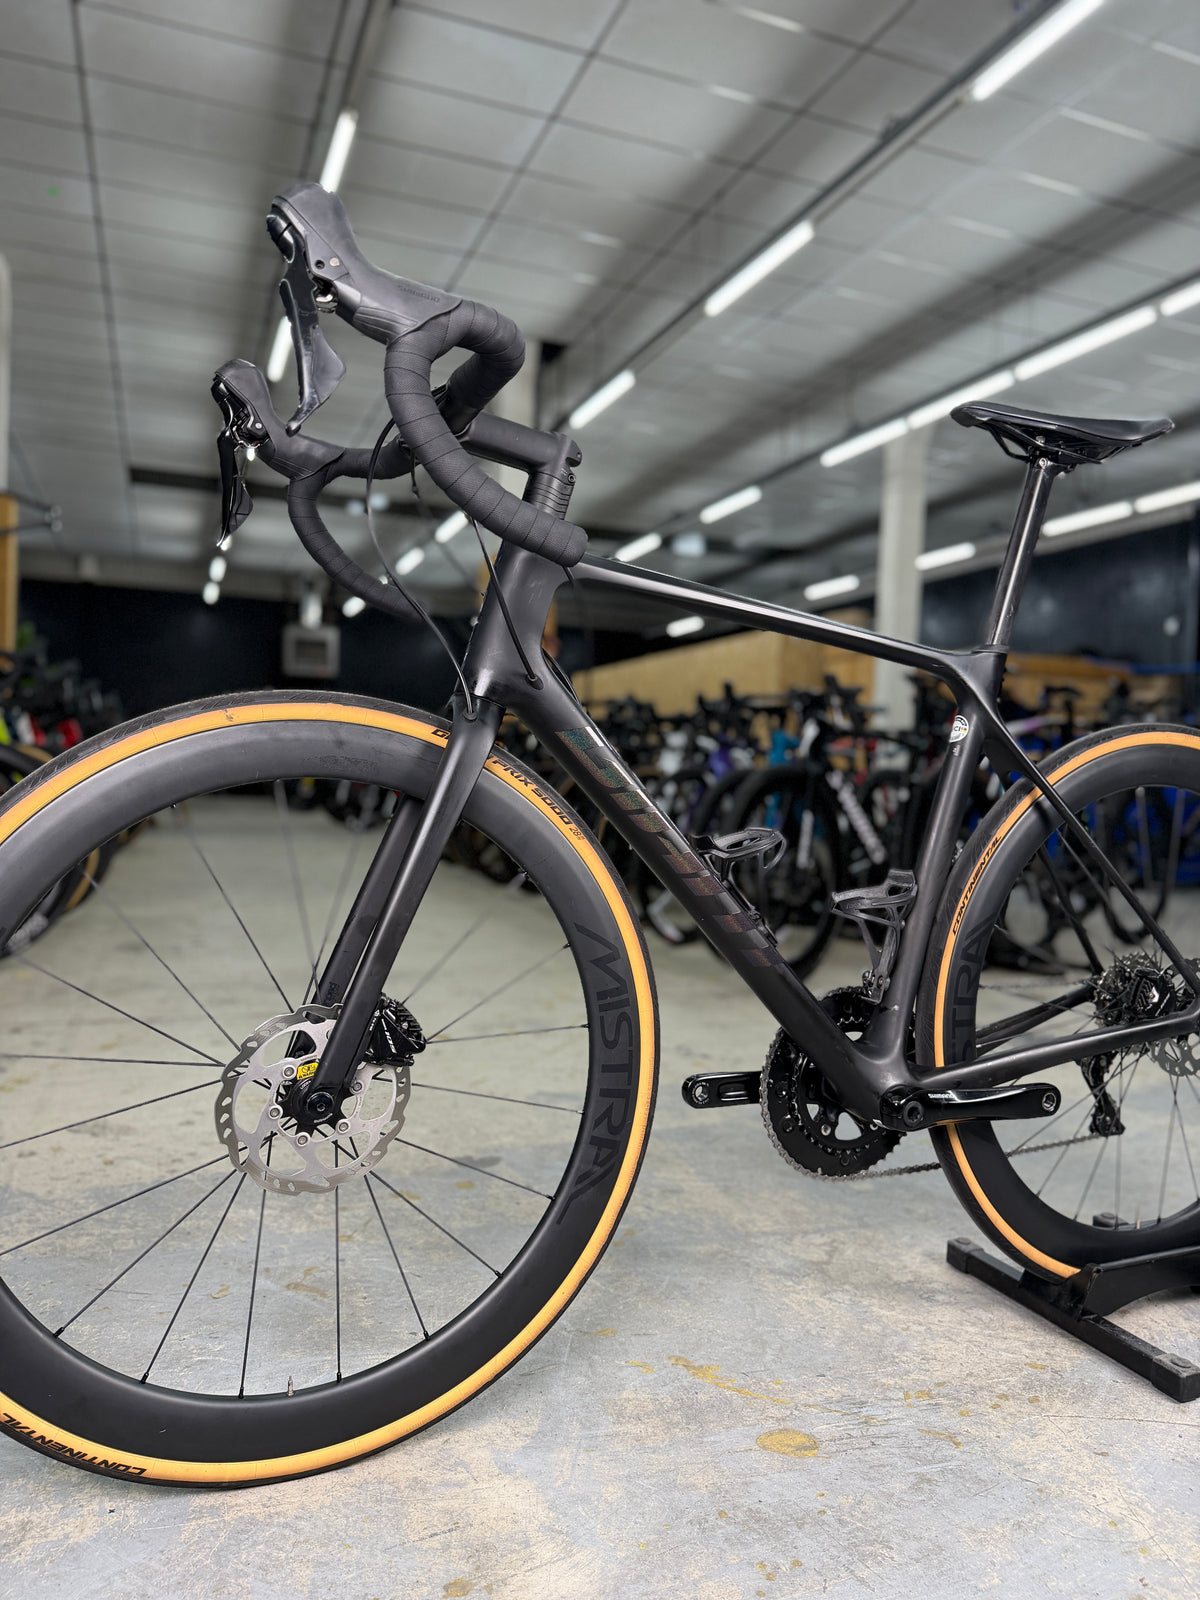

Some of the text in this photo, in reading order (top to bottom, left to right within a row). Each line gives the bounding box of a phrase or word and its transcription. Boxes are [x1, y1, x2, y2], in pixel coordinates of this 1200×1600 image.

[492, 760, 533, 787] PRIX
[531, 787, 573, 825] 5000
[953, 836, 1002, 936] CONTINENTAL
[2, 1412, 148, 1476] CONTINENTAL
